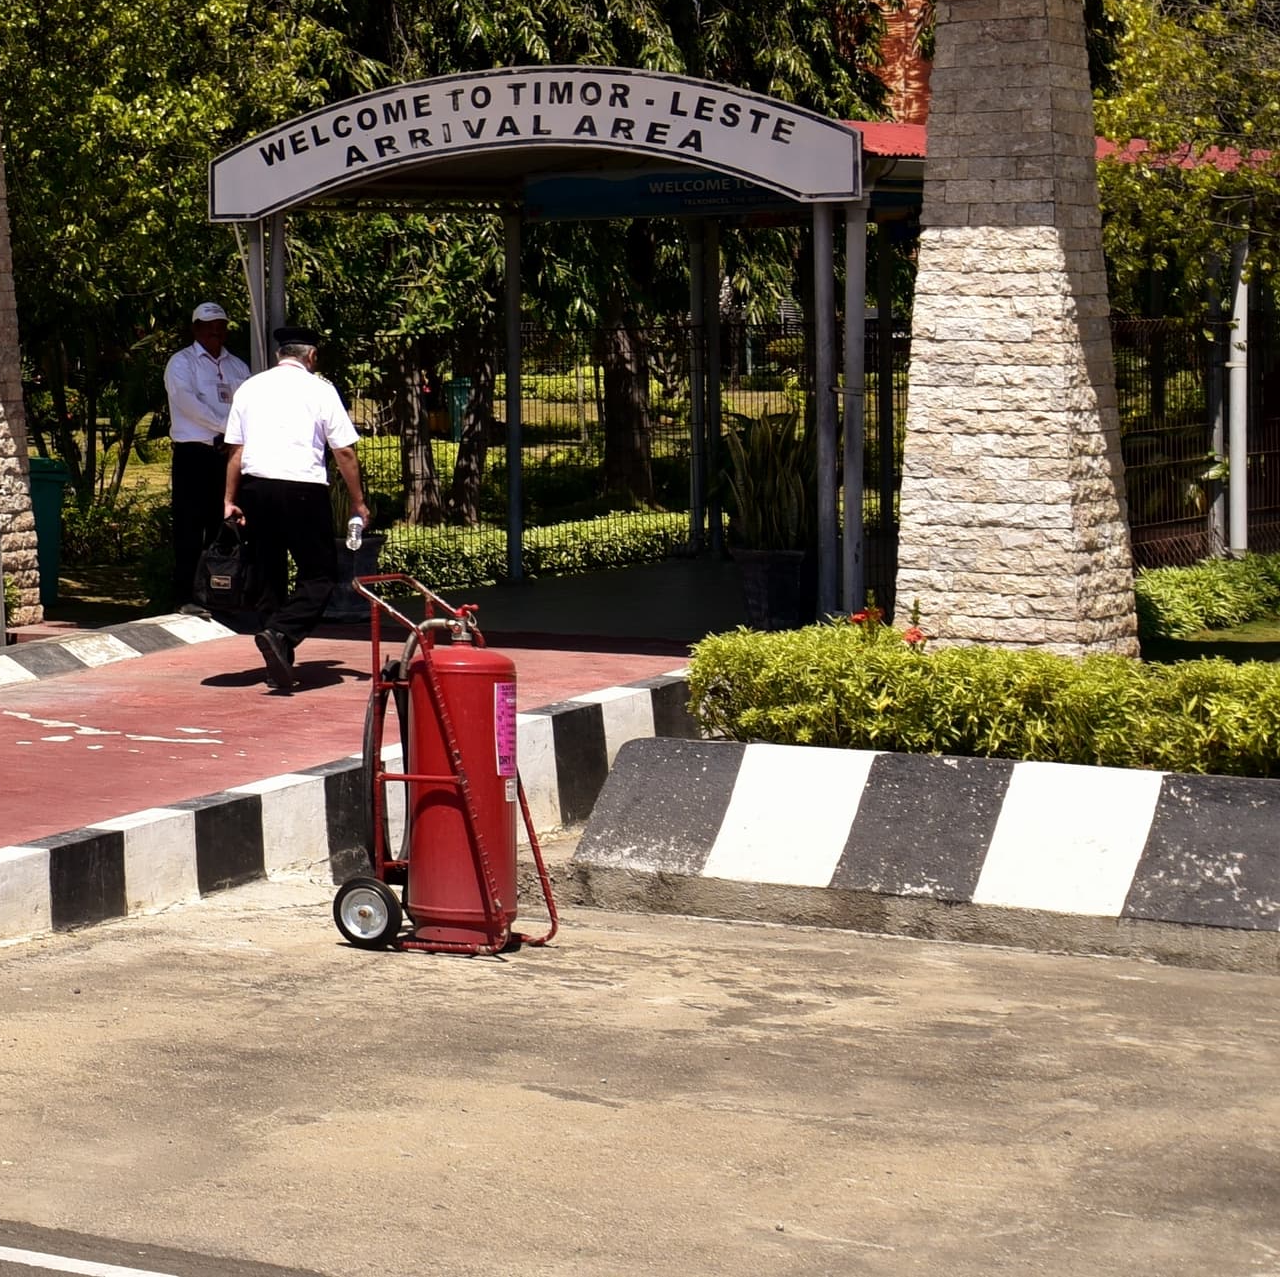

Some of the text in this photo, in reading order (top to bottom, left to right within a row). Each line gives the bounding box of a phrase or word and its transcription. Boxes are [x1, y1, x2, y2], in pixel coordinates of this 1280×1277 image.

[259, 94, 432, 166] WELCOME
[445, 88, 492, 112] TO
[507, 81, 631, 108] TIMOR
[670, 91, 795, 144] LESTE
[346, 115, 703, 167] ARRIVAL AREA
[648, 178, 731, 194] WELCOME
